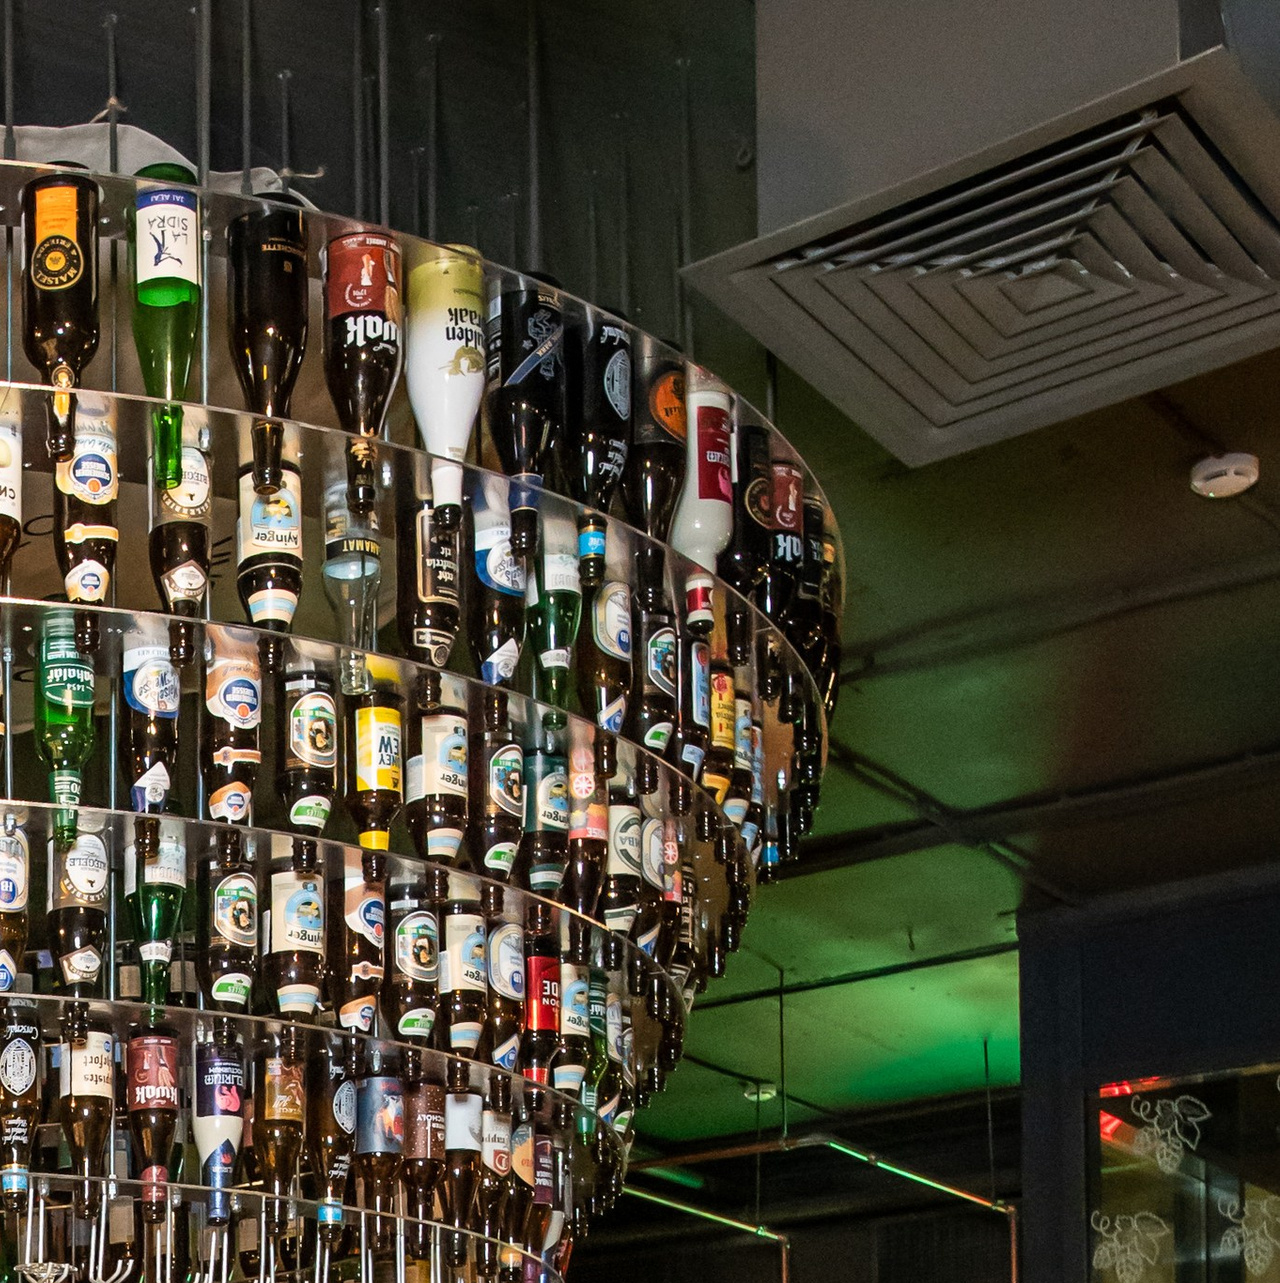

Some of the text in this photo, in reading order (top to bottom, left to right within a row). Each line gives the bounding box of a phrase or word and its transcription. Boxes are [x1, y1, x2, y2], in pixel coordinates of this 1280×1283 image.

[150, 194, 170, 204] ALAI
[147, 216, 189, 231] SIDRA
[171, 233, 188, 245] LA
[255, 531, 299, 547] Ayinger
